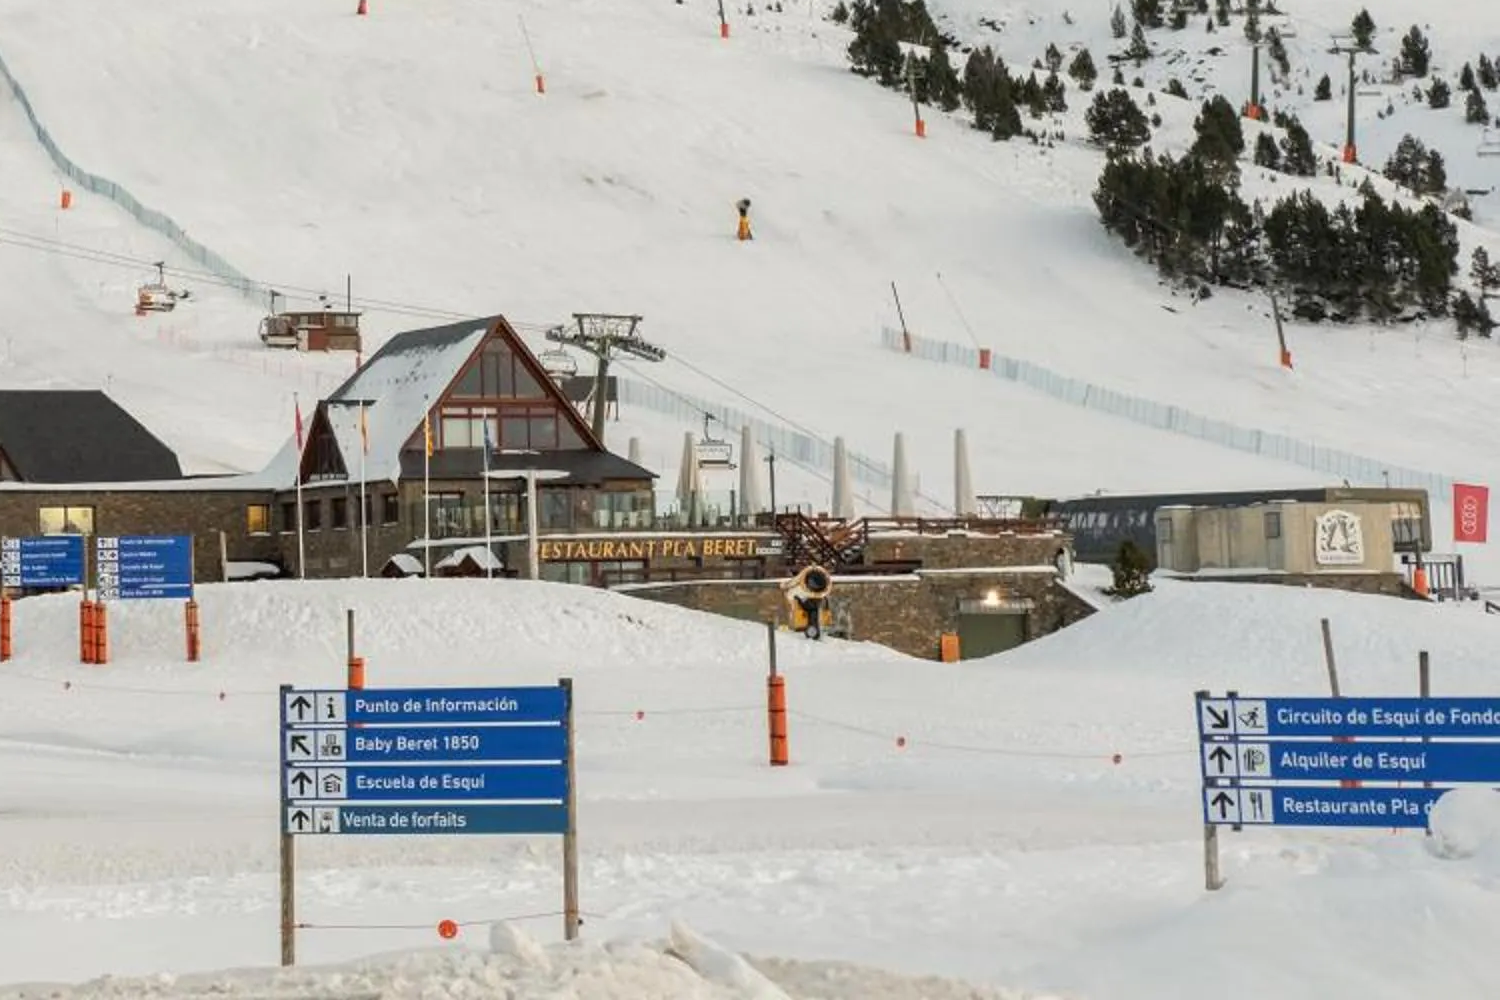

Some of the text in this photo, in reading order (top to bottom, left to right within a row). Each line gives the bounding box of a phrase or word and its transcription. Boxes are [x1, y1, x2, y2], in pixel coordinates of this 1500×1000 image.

[540, 541, 655, 559] ESTAURANT
[663, 540, 696, 557] PLA
[704, 540, 757, 556] BERET
[355, 697, 518, 713] Punto de Información
[1277, 708, 1343, 725] Circuito
[1347, 709, 1367, 725] de
[1372, 708, 1420, 728] Esquí
[1424, 709, 1445, 725] de
[355, 736, 480, 753] Baby Beret 1850
[1281, 751, 1426, 772] Alquiler de Esquí
[356, 773, 485, 791] Escuela de Esquí
[1283, 798, 1386, 815] Restaurante
[1392, 799, 1419, 815] Pla
[343, 811, 467, 827] Venta de forfaits
